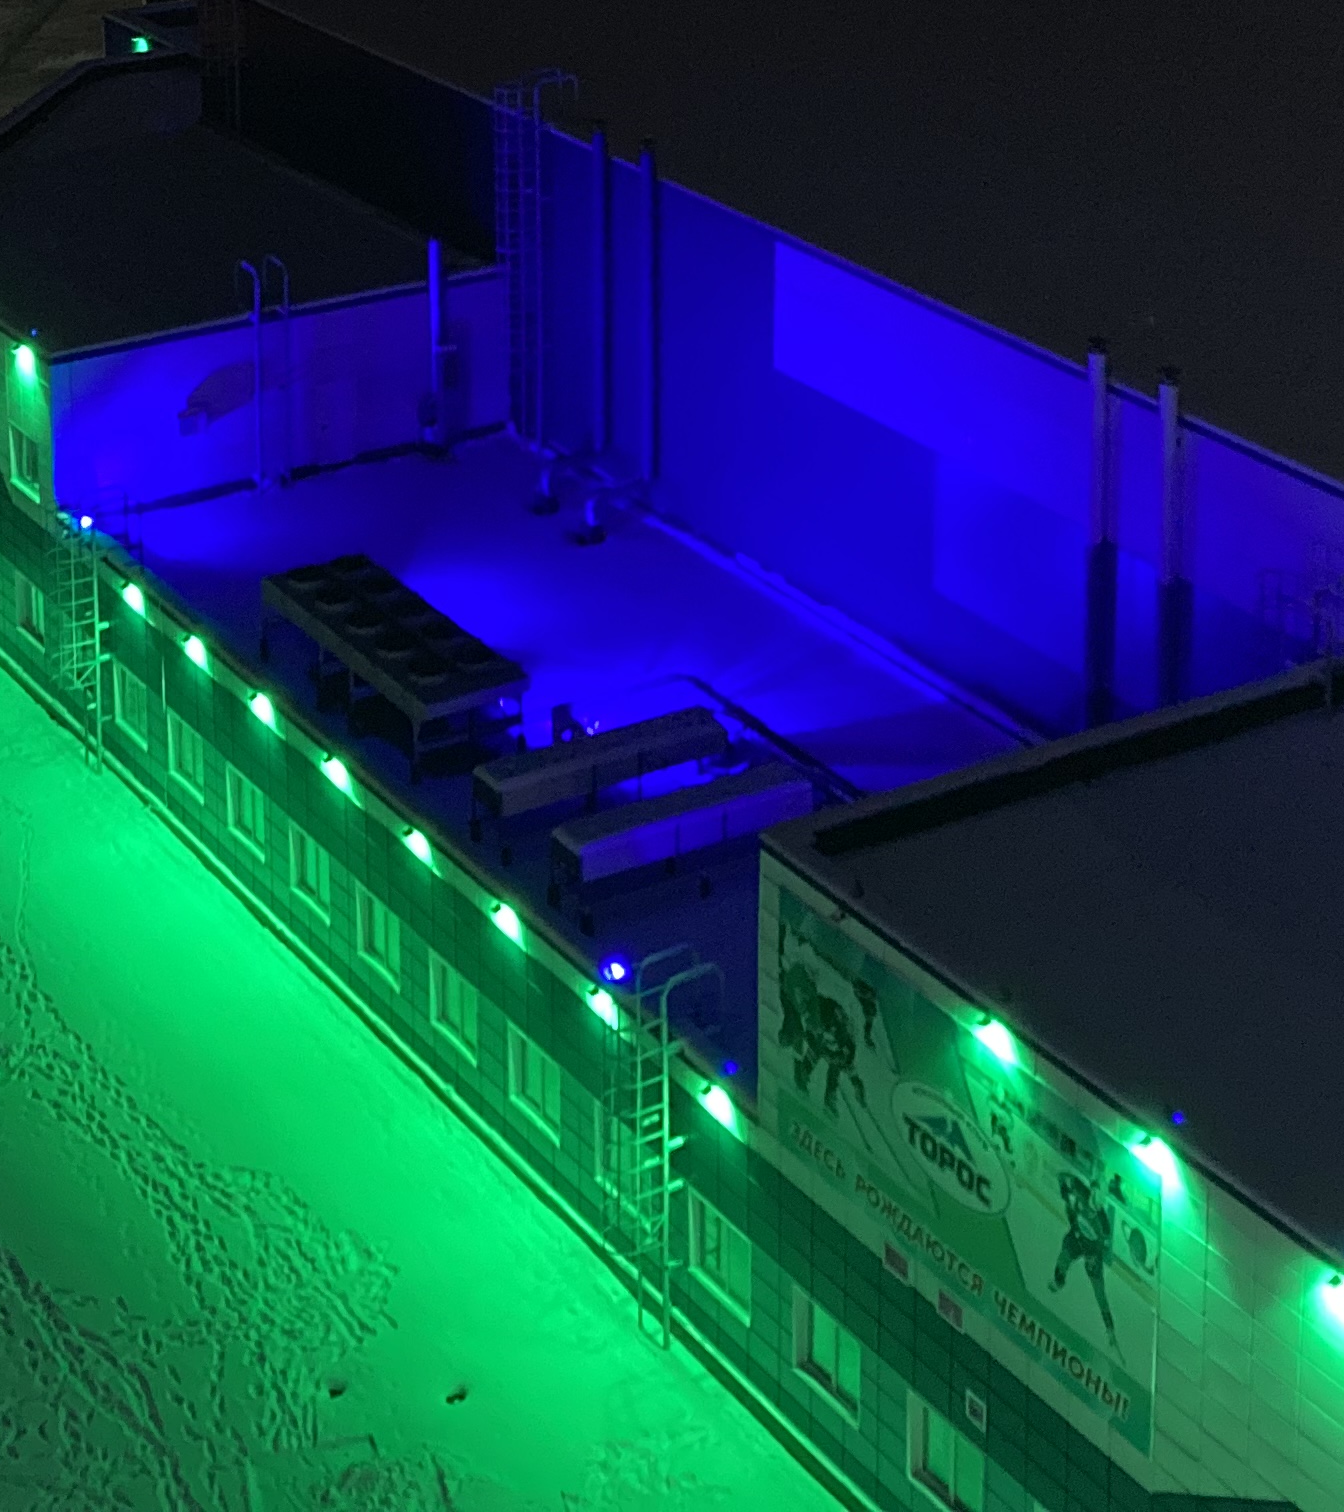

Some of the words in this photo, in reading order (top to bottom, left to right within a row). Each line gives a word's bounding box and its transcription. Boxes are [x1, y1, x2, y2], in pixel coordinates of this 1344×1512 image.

[903, 1112, 991, 1207] ТОРОС
[793, 1120, 845, 1179] ЗДЕСЬ
[856, 1174, 983, 1296] РОЖДАЮТСЯ
[994, 1291, 1129, 1421] ЧЕМПИОНЫ!
